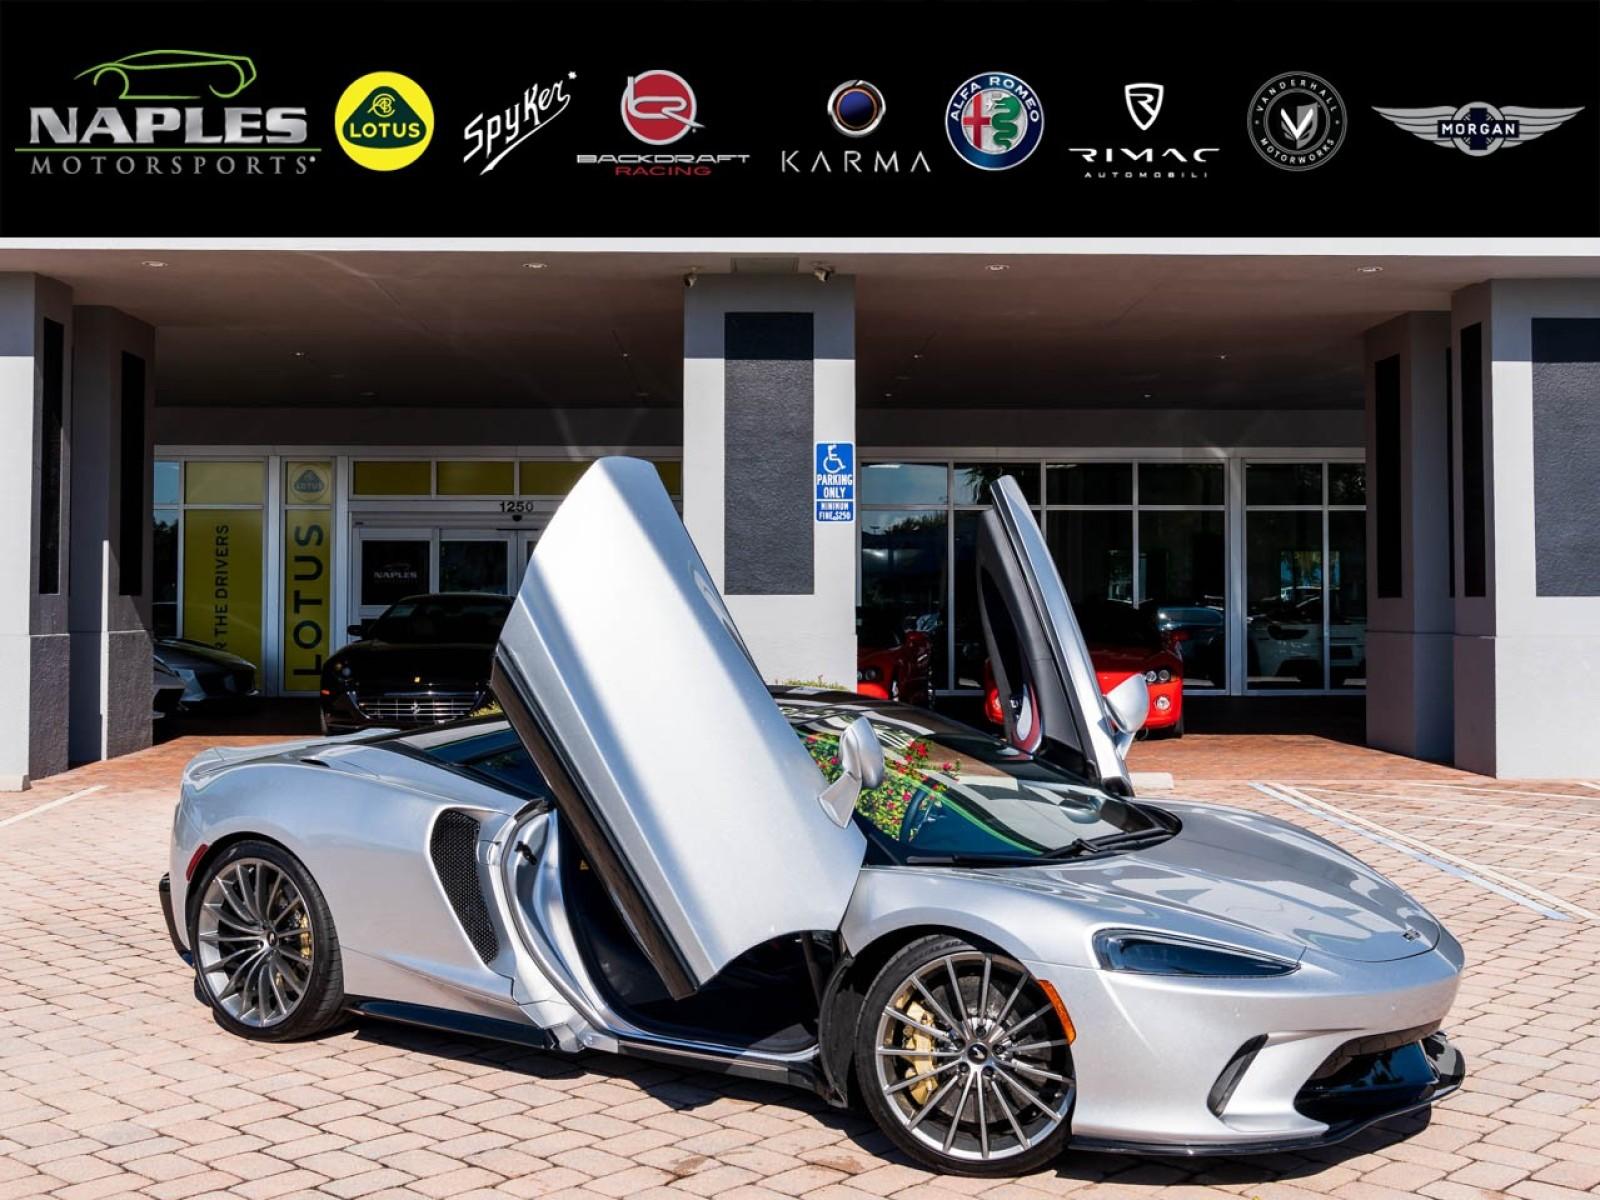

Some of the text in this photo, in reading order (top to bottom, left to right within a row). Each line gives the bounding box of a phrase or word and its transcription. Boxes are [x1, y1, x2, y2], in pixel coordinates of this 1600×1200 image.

[816, 474, 853, 486] PARKING
[823, 487, 846, 498] ONLY
[500, 501, 534, 513] 1250
[215, 524, 229, 599] DRIVERS
[374, 571, 418, 579] NAPLES
[294, 524, 323, 676] LOTUS
[214, 604, 228, 638] THE
